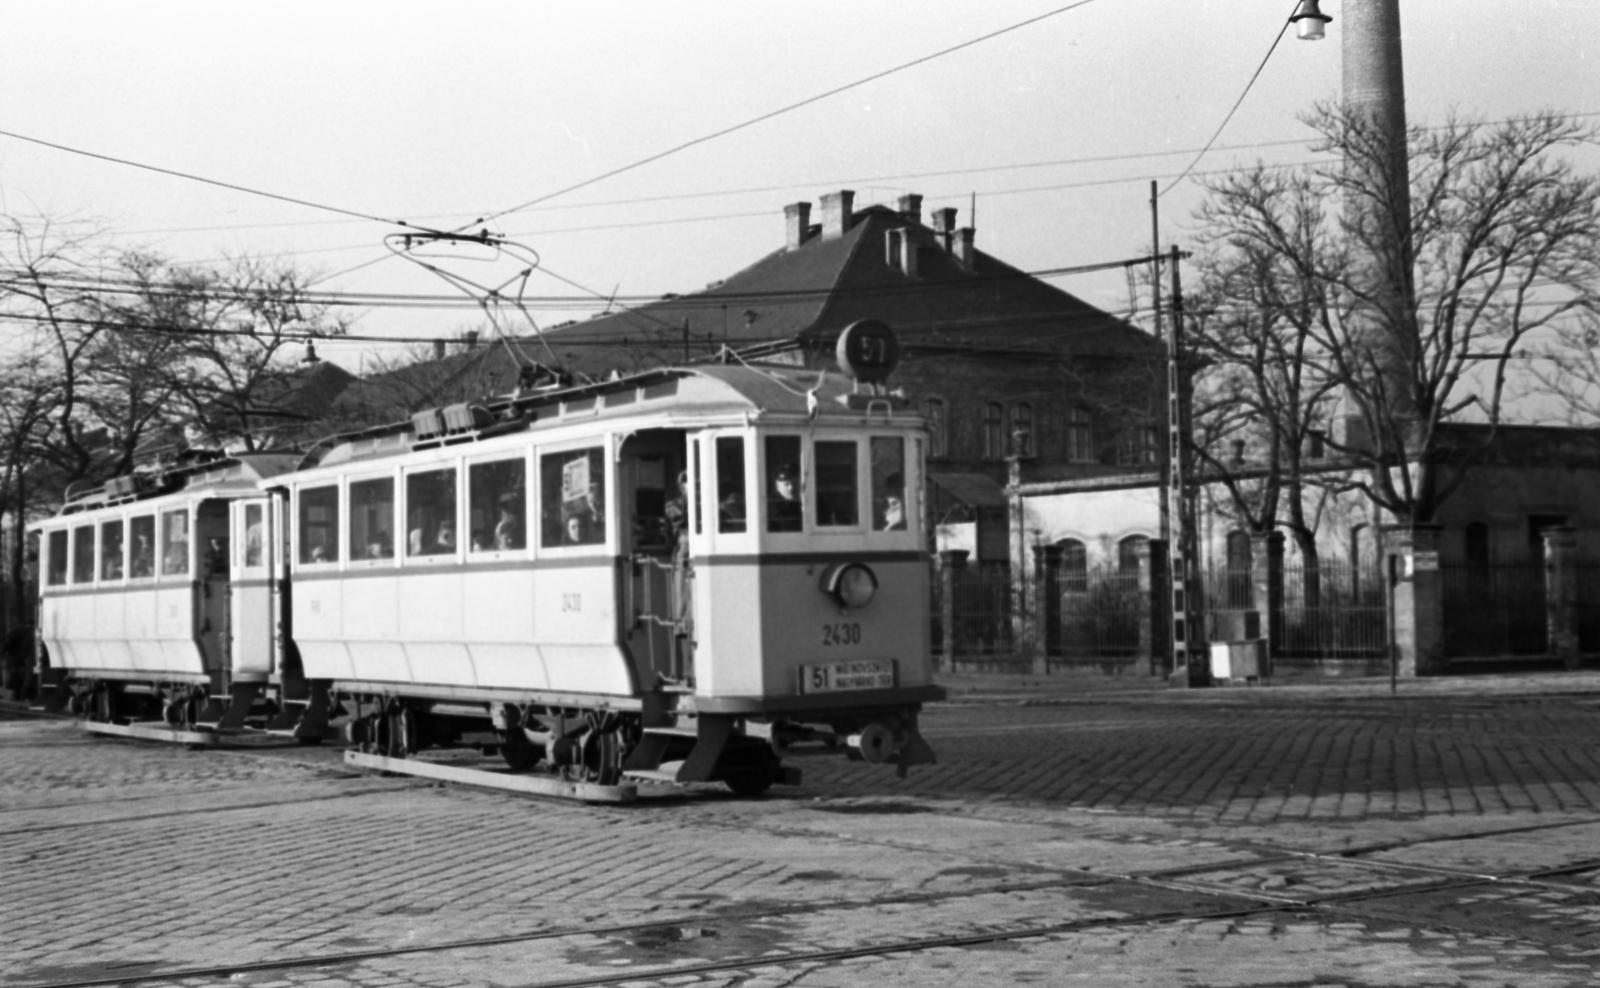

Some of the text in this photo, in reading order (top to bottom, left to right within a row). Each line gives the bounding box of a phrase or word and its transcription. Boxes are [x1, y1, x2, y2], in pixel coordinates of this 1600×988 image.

[862, 336, 885, 363] 51
[822, 622, 861, 646] 2430
[813, 667, 828, 689] 51
